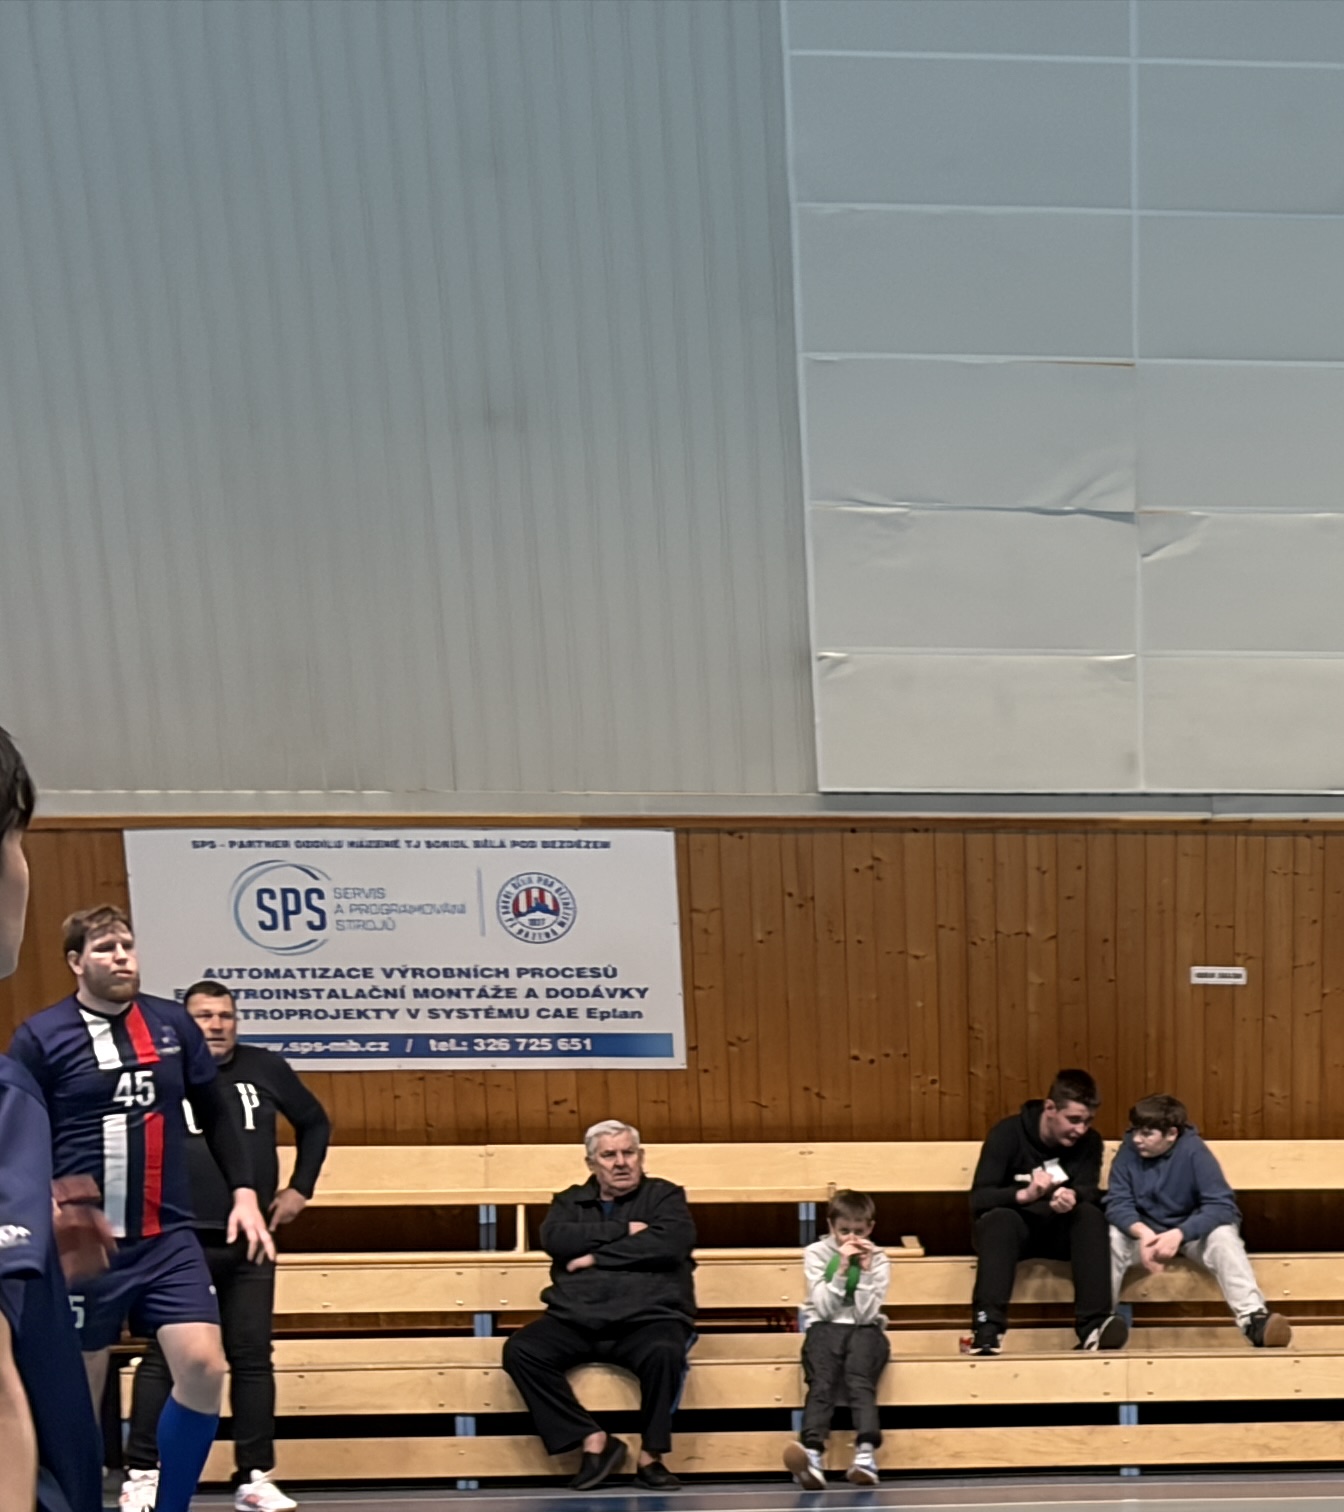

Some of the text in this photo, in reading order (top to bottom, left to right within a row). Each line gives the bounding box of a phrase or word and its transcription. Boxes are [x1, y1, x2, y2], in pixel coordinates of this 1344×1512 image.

[333, 887, 387, 899] SERVIS
[256, 887, 327, 932] SPS
[334, 903, 345, 914] A
[203, 964, 618, 979] AUTOMATIZACE VÝROBNÍCH PROCESŮ
[174, 984, 649, 1000] ETROINSTALAČNÍ MONTÁŽE A DODÁVKY
[406, 1008, 420, 1020] V
[427, 1005, 530, 1020] SYSTÉMU
[536, 1007, 579, 1020] CAE
[586, 1007, 644, 1022] Eplan
[473, 1038, 511, 1052] 326
[516, 1038, 553, 1052] 725
[558, 1037, 593, 1052] 651
[113, 1070, 156, 1107] 45
